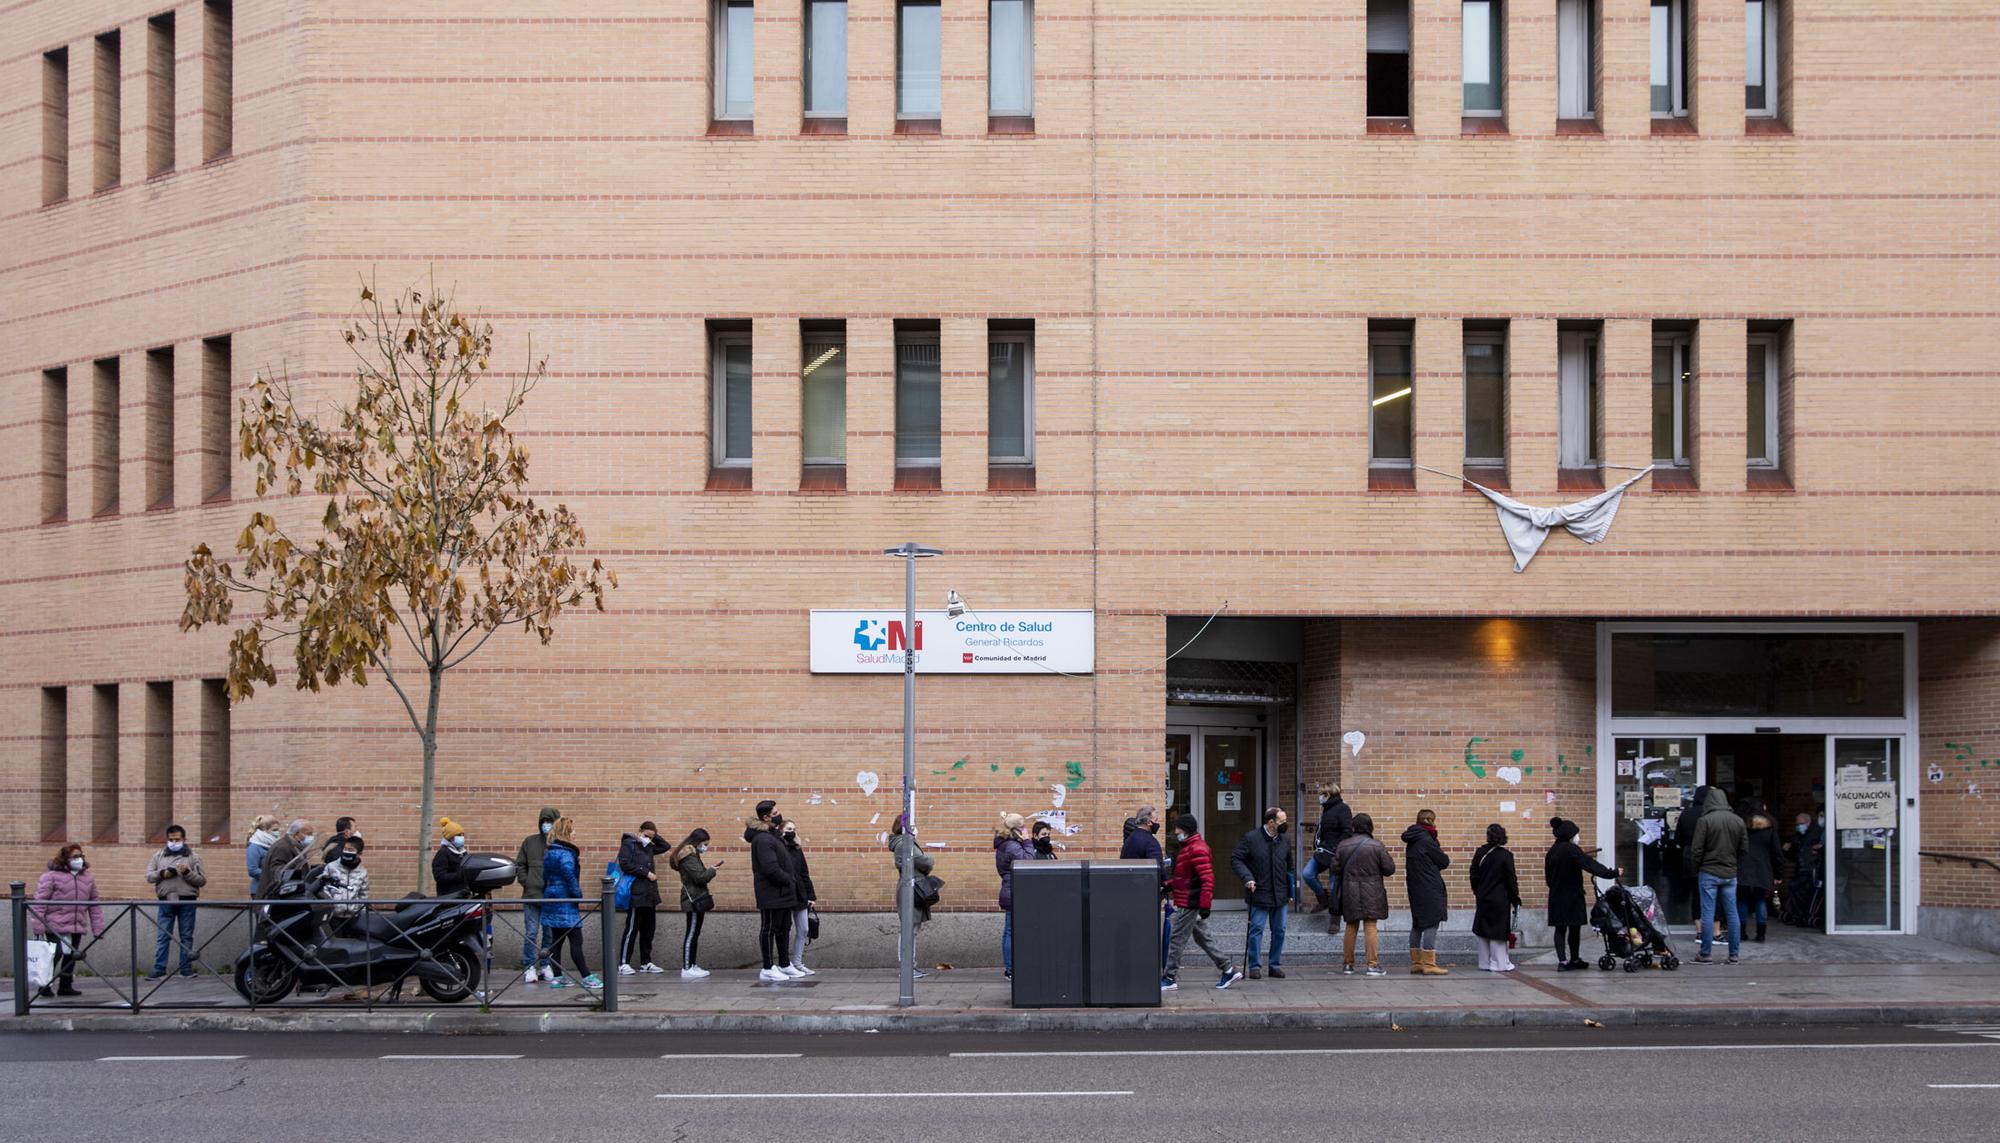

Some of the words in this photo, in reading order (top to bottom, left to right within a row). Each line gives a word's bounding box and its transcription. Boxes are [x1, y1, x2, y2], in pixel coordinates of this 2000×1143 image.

[956, 621, 996, 632] Centro
[1000, 622, 1015, 632] de
[1018, 621, 1052, 632] Salud
[888, 620, 922, 650] M
[965, 637, 1000, 647] General
[1003, 637, 1044, 647] Ricardos
[856, 653, 920, 664] SaludMad
[1836, 791, 1891, 800] VACUNACIÓN
[1854, 801, 1879, 810] GRIPE
